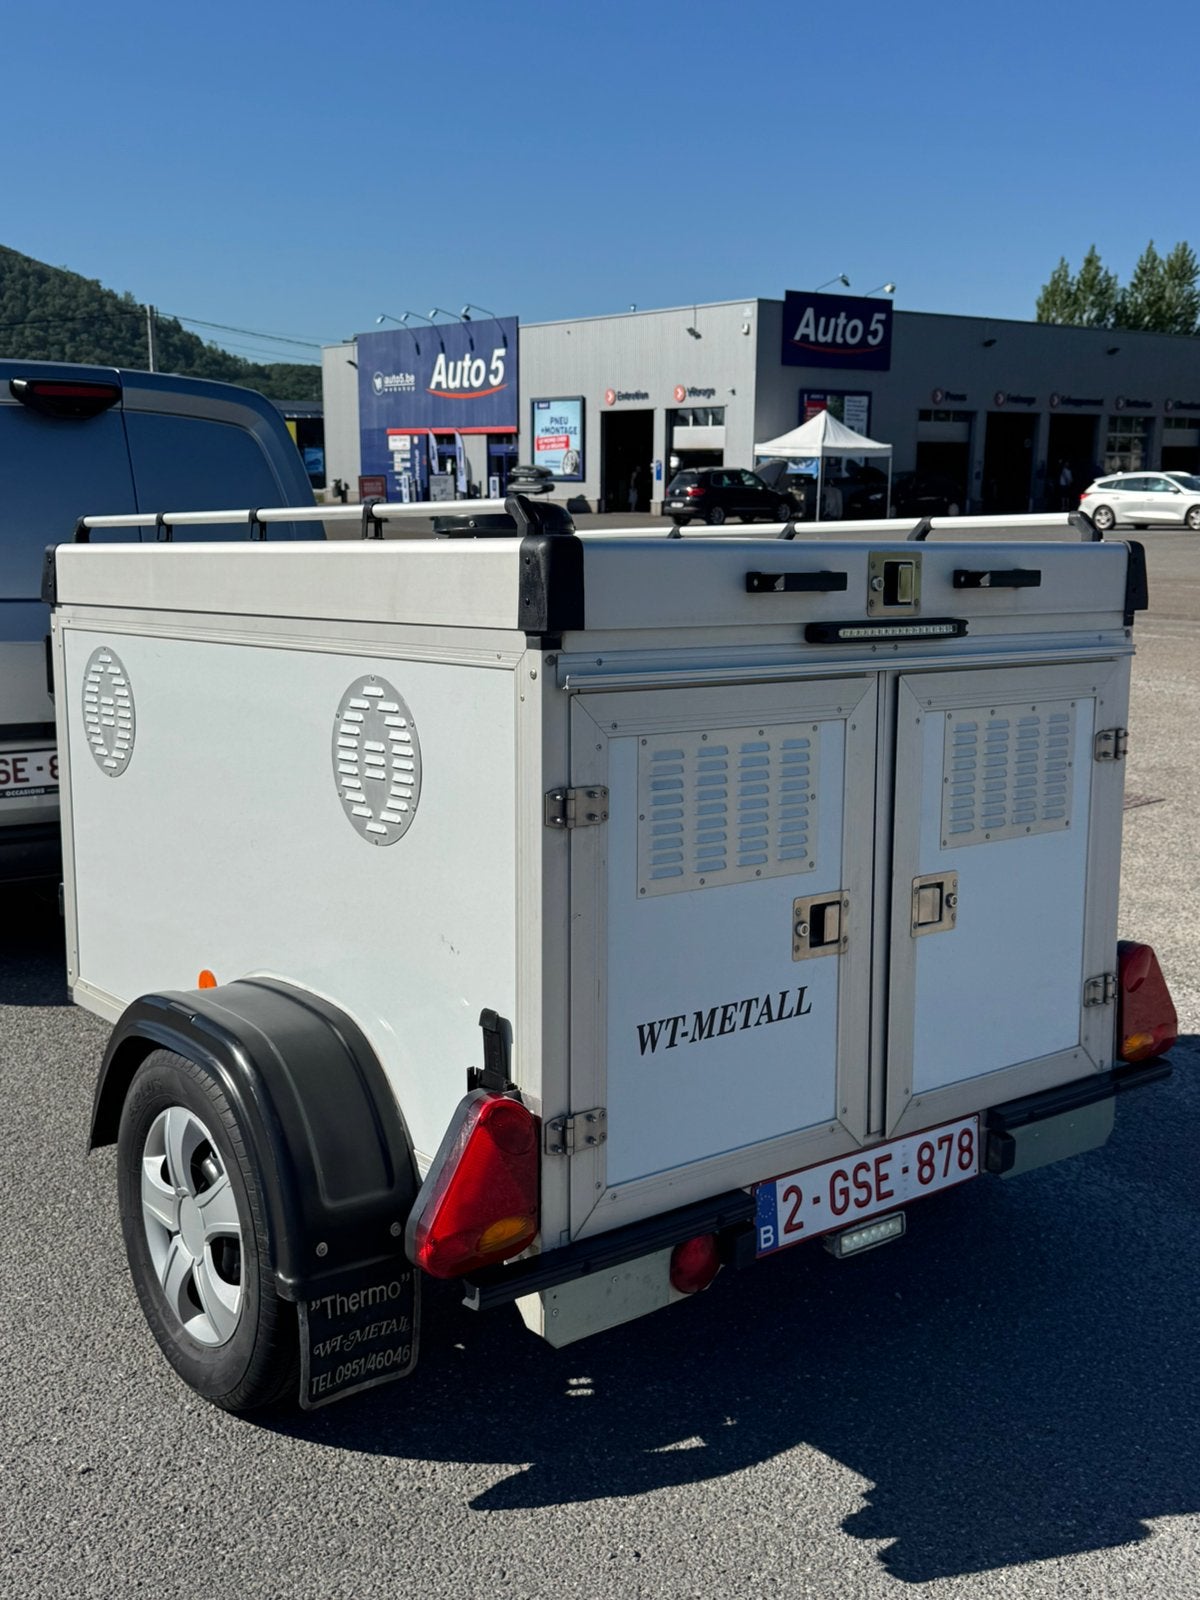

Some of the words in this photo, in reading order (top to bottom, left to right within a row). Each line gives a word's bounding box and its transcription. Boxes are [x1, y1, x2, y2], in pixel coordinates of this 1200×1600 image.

[794, 306, 863, 345] Auto
[867, 312, 887, 346] 5
[430, 352, 486, 389] Auto
[489, 348, 506, 386] 5
[5, 787, 45, 797] OCCASIONS
[636, 986, 812, 1056] WT-METALL
[782, 1128, 974, 1235] 2-GSE-878
[759, 1225, 774, 1249] B
